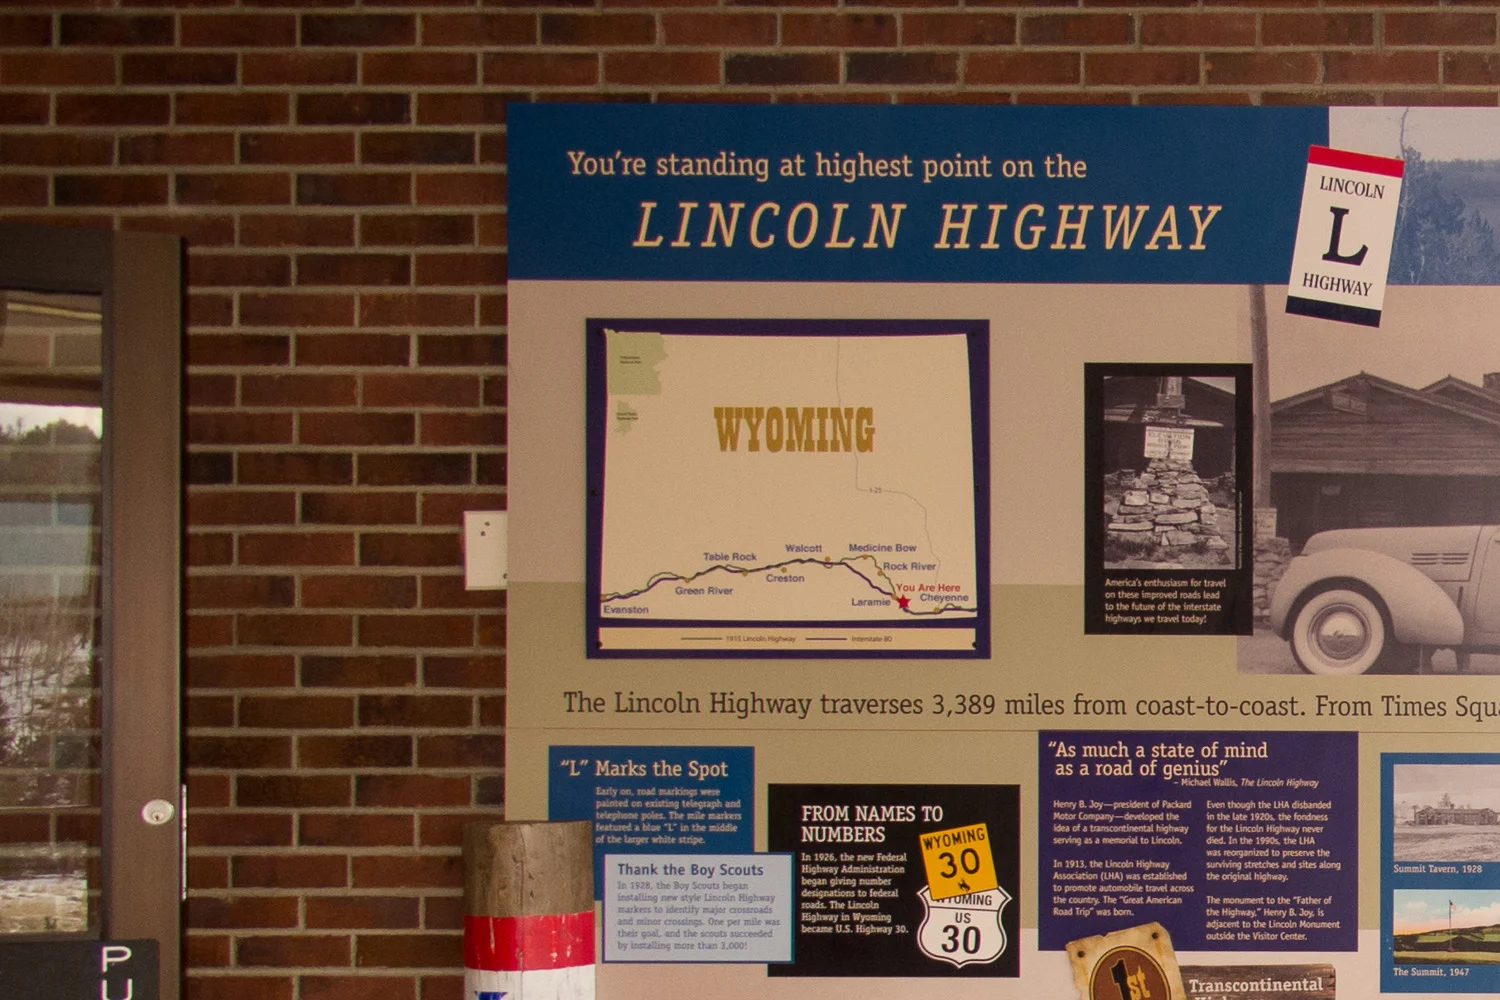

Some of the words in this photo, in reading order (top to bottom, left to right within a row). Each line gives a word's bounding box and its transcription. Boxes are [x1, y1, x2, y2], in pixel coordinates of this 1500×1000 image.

[657, 151, 769, 183] standing
[780, 154, 806, 177] at
[816, 152, 913, 183] highest
[923, 153, 992, 183] point
[1002, 160, 1034, 178] on
[1044, 153, 1087, 178] the
[1320, 176, 1386, 200] LINCOLN
[633, 202, 907, 249] LINCOLN
[935, 204, 1222, 250] HIGHWAY
[1322, 206, 1369, 267] L
[1302, 272, 1373, 298] HIGHWAY
[714, 406, 876, 454] WYOMING
[784, 543, 824, 554] Walcott
[848, 543, 892, 553] Medicine
[895, 543, 918, 553] Bow
[703, 552, 730, 563] Table
[732, 552, 758, 564] Rock
[882, 561, 909, 571] Rock
[910, 561, 938, 571] River
[765, 573, 806, 583] Creston
[1143, 578, 1189, 588] enthusiasm
[1190, 578, 1202, 588] for
[1203, 578, 1227, 588] travel
[674, 586, 706, 596] Green
[707, 586, 734, 596] River
[895, 583, 916, 593] You
[917, 583, 936, 593] Are
[937, 583, 962, 593] Here
[851, 597, 892, 608] Laramie
[919, 592, 970, 604] Cheyenne
[602, 604, 650, 615] Evanston
[563, 690, 606, 713] The
[614, 691, 701, 714] Lincoln
[710, 691, 813, 720] Highway
[820, 694, 924, 715] traverses
[932, 694, 996, 718] 3,389
[1005, 692, 1065, 715] miles
[1073, 693, 1127, 716] from
[1136, 696, 1306, 717] coast-to-coast.
[1316, 695, 1373, 717] From
[1381, 694, 1447, 717] Times
[1082, 741, 1130, 758] much
[1135, 745, 1146, 758] a
[1151, 743, 1195, 758] state
[1201, 741, 1219, 758] of
[1224, 741, 1268, 758] mind
[595, 759, 647, 777] Marks
[652, 760, 682, 777] the
[688, 760, 729, 781] Spot
[1055, 763, 1074, 776] as
[1079, 763, 1090, 776] a
[1096, 759, 1134, 776] road
[1140, 759, 1158, 776] of
[1180, 777, 1212, 788] Michael
[1241, 777, 1256, 787] The
[1256, 777, 1285, 788] Lincoln
[1286, 778, 1320, 790] Highway
[1206, 800, 1226, 810] Even
[1226, 800, 1256, 812] though
[1257, 800, 1272, 810] the
[1273, 800, 1290, 810] LHA
[1291, 800, 1332, 810] disbanded
[802, 805, 850, 822] FROM
[855, 806, 916, 822] NAMES
[921, 806, 944, 822] TO
[800, 826, 888, 844] NUMBERS
[922, 828, 986, 851] WYOMING
[801, 852, 812, 862] In
[839, 852, 856, 862] the
[856, 854, 876, 862] new
[876, 852, 908, 862] Federal
[938, 848, 981, 880] 30
[617, 862, 659, 876] Thank
[662, 862, 686, 876] the
[691, 864, 715, 879] Boy
[719, 863, 764, 877] Scouts
[801, 863, 840, 877] Highway
[840, 862, 906, 877] Administration
[1052, 859, 1063, 869] In
[1089, 859, 1104, 869] the
[1104, 859, 1136, 869] Lincoln
[1136, 859, 1171, 871] Highway
[1393, 864, 1427, 874] Summit
[1462, 864, 1484, 874] 1928
[954, 912, 972, 924] US
[942, 924, 982, 955] 30
[1392, 967, 1410, 977] The
[1450, 967, 1470, 977] 1947
[1188, 976, 1324, 994] Transcontinental
